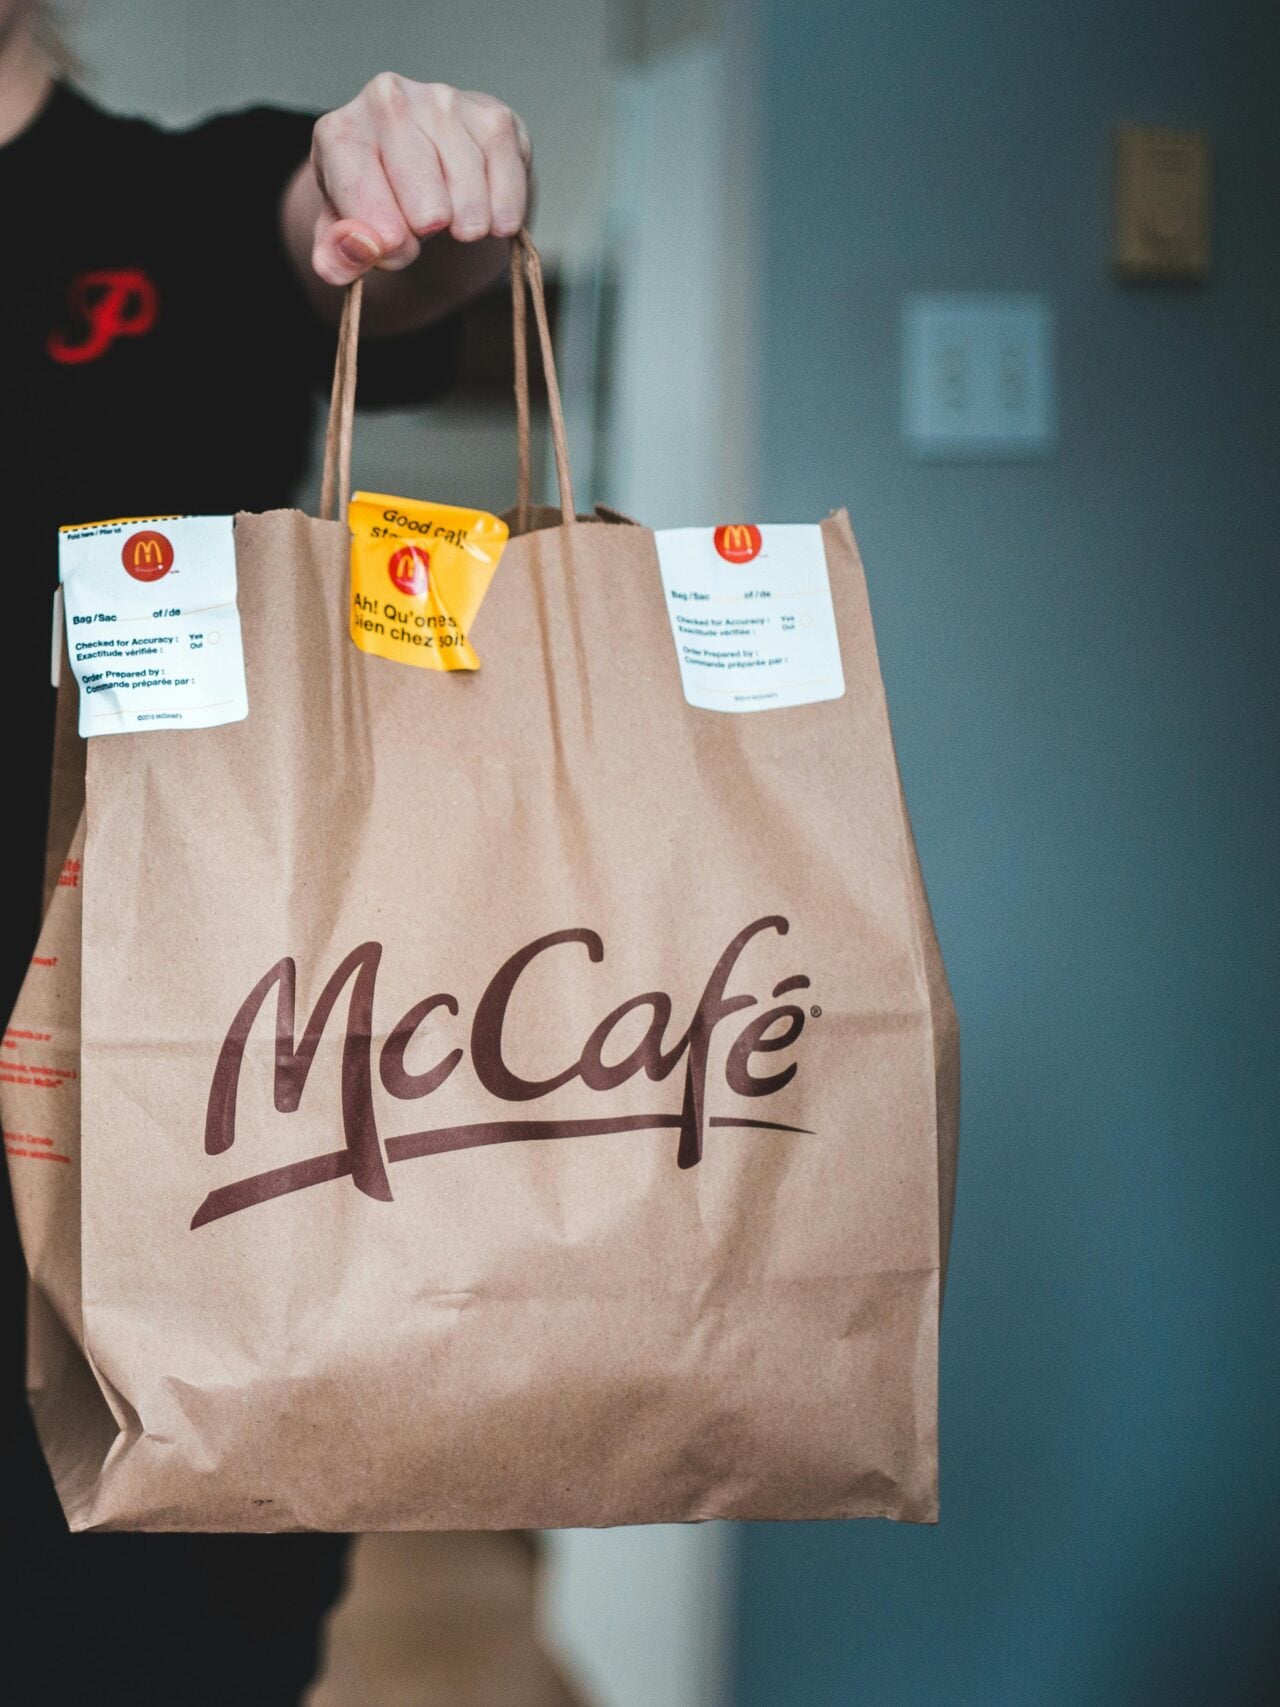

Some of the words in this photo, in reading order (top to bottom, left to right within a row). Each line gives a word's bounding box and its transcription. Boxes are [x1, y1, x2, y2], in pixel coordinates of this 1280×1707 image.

[383, 509, 433, 534] Good
[354, 593, 378, 615] Ah!
[76, 639, 114, 651] Checked
[116, 639, 129, 647] for
[131, 636, 174, 646] Accuracy
[190, 642, 203, 650] Oui
[390, 628, 433, 648] chez
[77, 650, 123, 661] Exactitude
[125, 648, 158, 656] vérifiée
[82, 672, 104, 684] Order
[106, 669, 147, 679] Prepared
[149, 668, 160, 677] by
[86, 681, 130, 694] Commande
[132, 678, 172, 690] préparée
[174, 678, 190, 687] par
